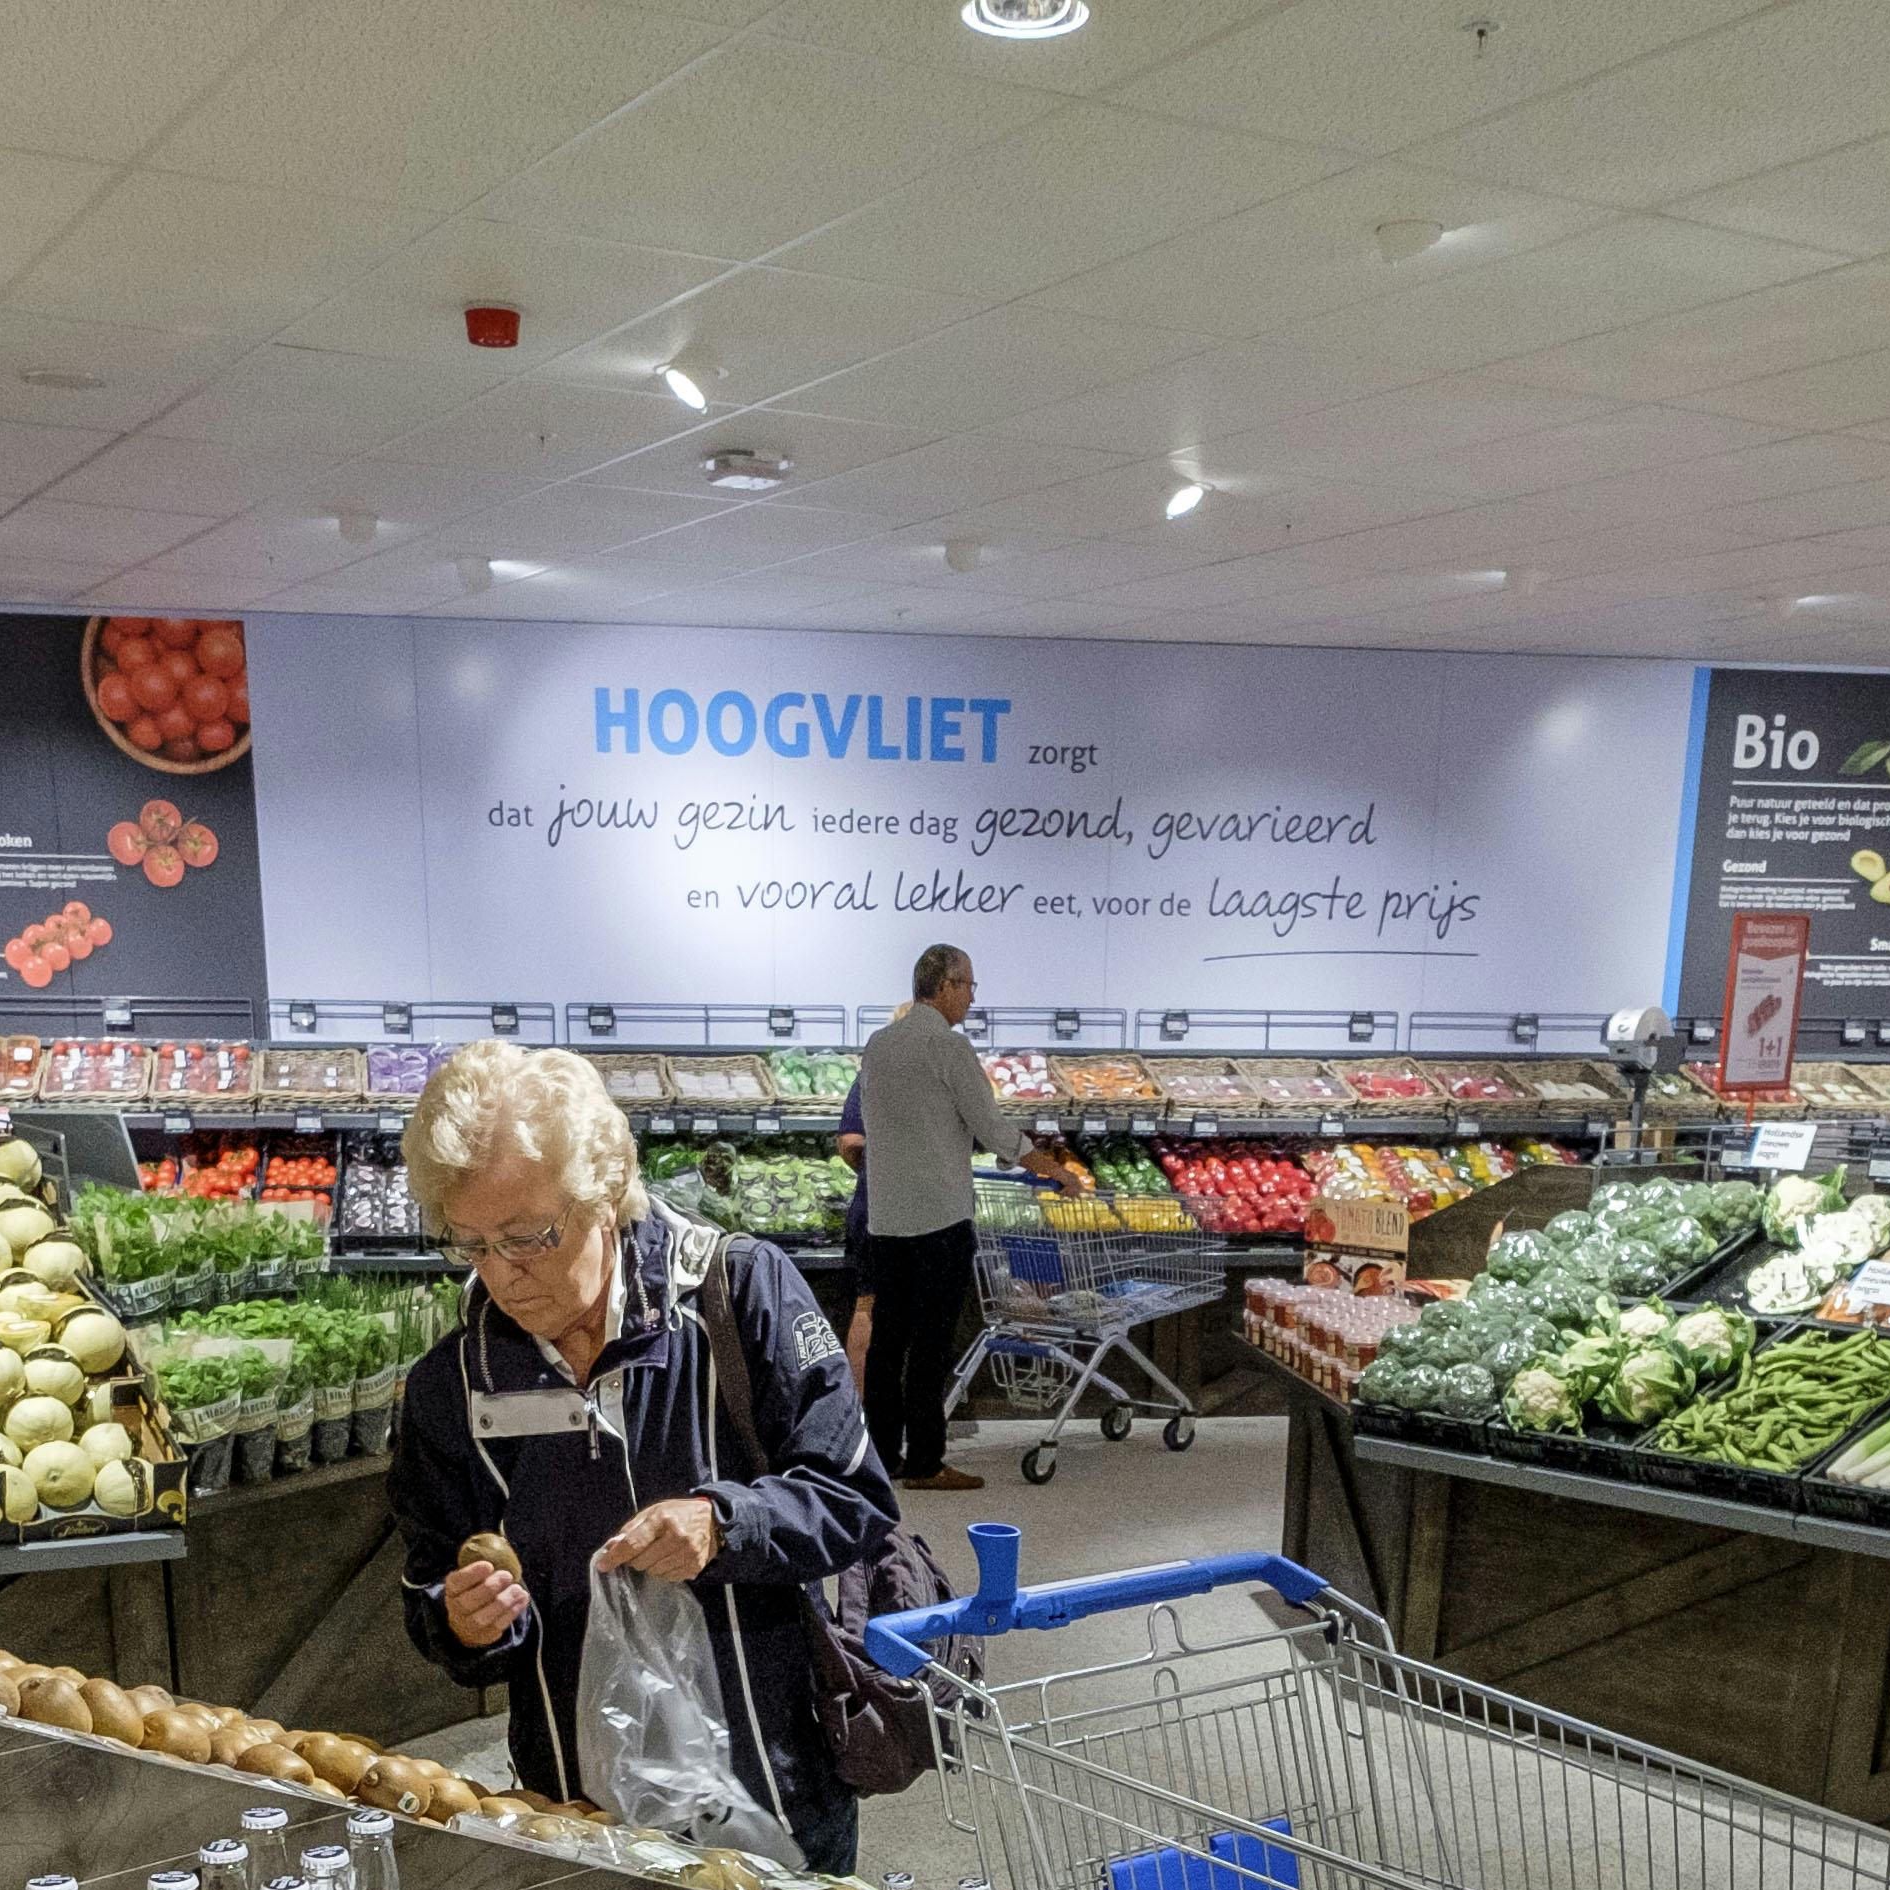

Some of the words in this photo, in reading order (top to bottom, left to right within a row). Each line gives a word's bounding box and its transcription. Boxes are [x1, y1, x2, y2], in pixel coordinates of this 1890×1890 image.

[593, 686, 1011, 764] HOOGVLIET
[1028, 741, 1099, 774] zorgt
[1732, 713, 1820, 770] Bio
[1729, 795, 1754, 809] Puur
[1757, 796, 1791, 810] natuur
[1794, 798, 1835, 812] geteeld
[1837, 801, 1851, 811] en
[1853, 799, 1871, 811] dat
[488, 800, 534, 828] dat
[547, 782, 659, 847] jouw
[674, 794, 795, 850] gezin
[812, 808, 901, 834] iedere
[910, 809, 959, 843] dag
[972, 796, 1134, 857] gezond,
[1148, 803, 1377, 860] gevarieerd
[1727, 812, 1739, 825] je
[1775, 813, 1797, 825] Kies
[1798, 814, 1810, 827] je
[1812, 816, 1836, 826] voor
[1726, 829, 1747, 840] dan
[1749, 828, 1771, 840] kies
[1771, 829, 1782, 842] je
[1786, 830, 1810, 841] voor
[1811, 829, 1851, 844] gezond
[1722, 859, 1767, 873] Gezond
[686, 886, 720, 909] en
[736, 870, 878, 913] vooral
[893, 868, 1024, 914] lekker
[1033, 896, 1082, 919] eet,
[1092, 897, 1152, 917] voor
[1159, 892, 1192, 917] de
[1206, 875, 1367, 937] laagste
[1378, 880, 1481, 940] prijs
[1375, 1208, 1405, 1237] BLEND
